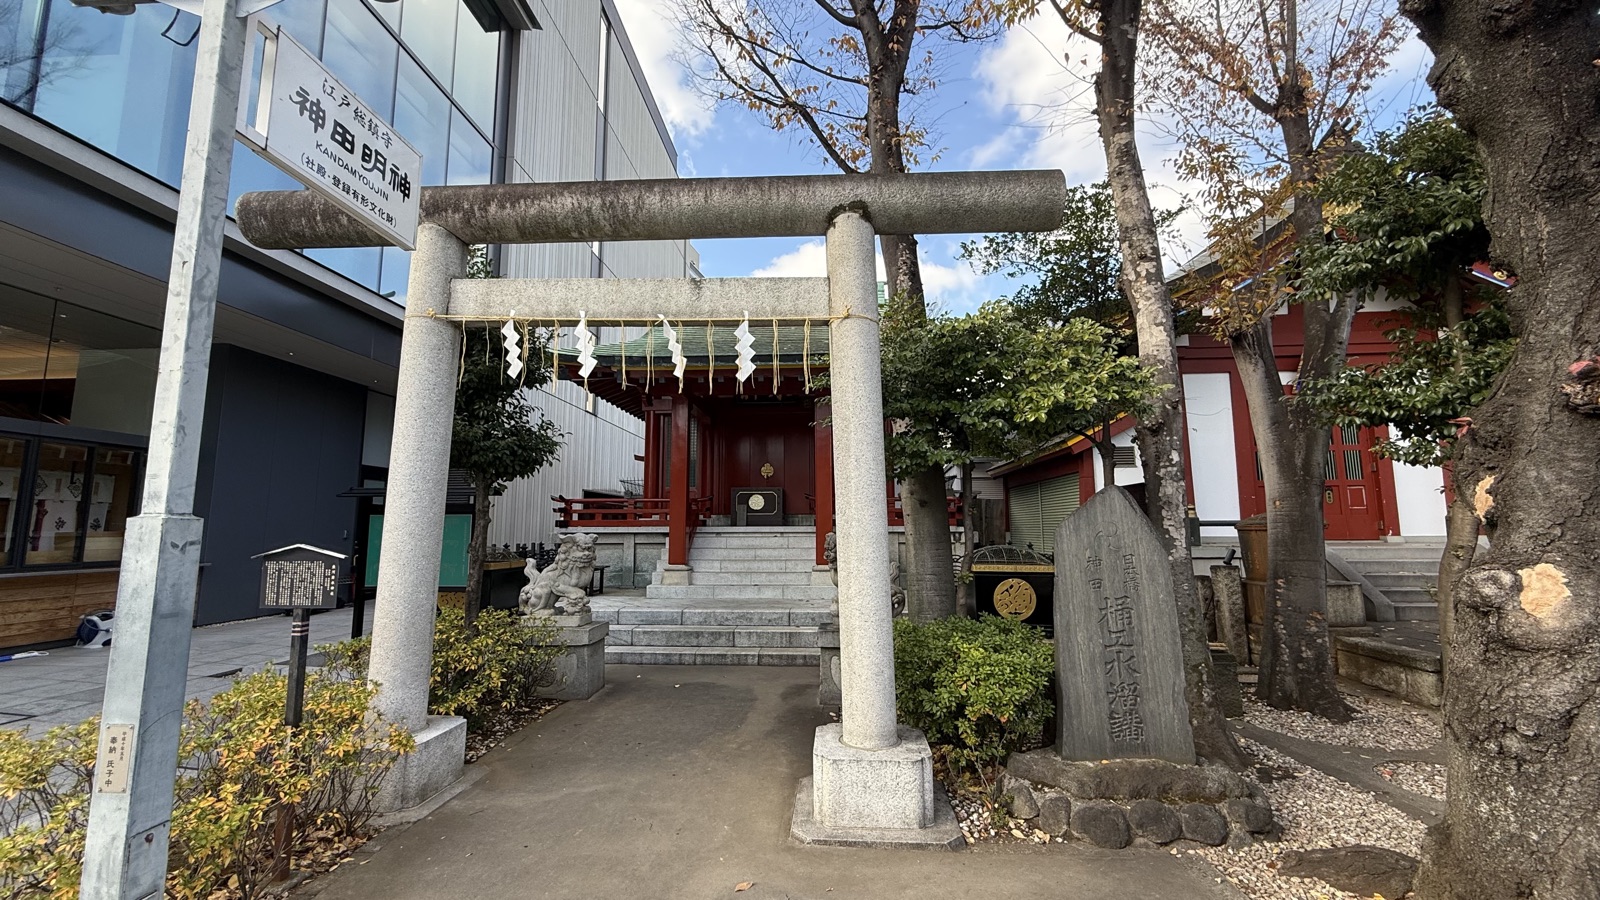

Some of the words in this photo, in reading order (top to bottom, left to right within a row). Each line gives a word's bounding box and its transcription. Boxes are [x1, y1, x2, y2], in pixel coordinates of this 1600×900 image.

[289, 86, 411, 203] 神田明神
[315, 140, 389, 201] KANDAMYOUJIN
[1086, 555, 1103, 590] 神田
[1123, 553, 1140, 592] 日本橋
